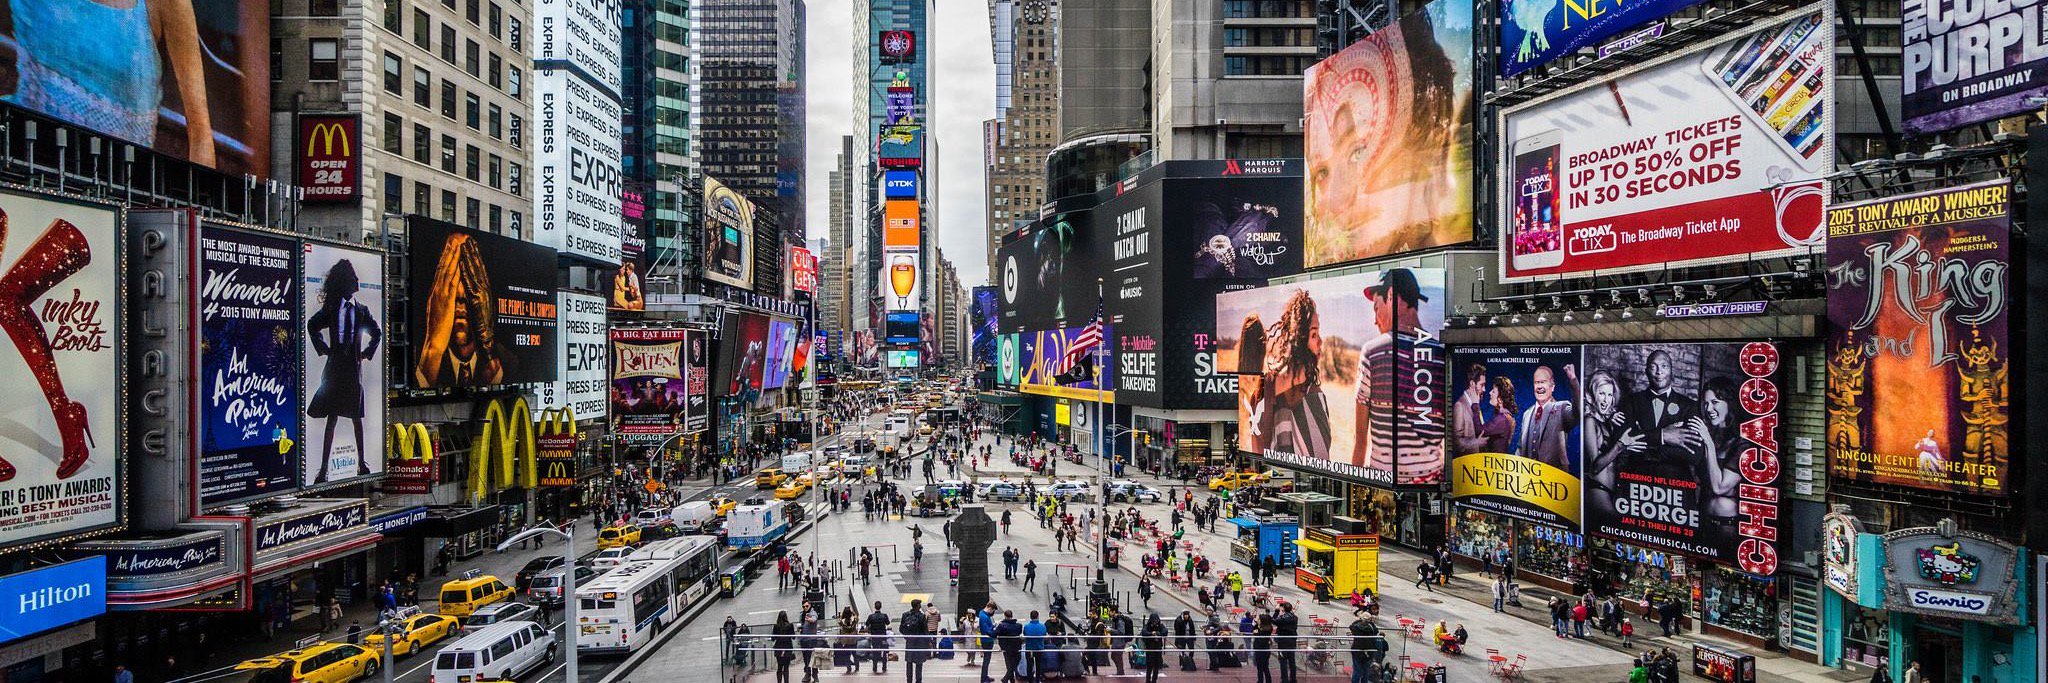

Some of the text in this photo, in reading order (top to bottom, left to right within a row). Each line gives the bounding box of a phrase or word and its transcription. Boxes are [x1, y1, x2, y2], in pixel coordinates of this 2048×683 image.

[576, 2, 606, 35] EXPRESS
[576, 48, 606, 80] EXPRESS
[1943, 69, 2033, 103] ON BROADWAY
[593, 98, 620, 122] EXPRESS
[543, 93, 554, 154] EXPRESS
[1569, 115, 1742, 168] BROADWAY TICKETS
[1569, 134, 1742, 188] UP TO 50% OFF
[315, 170, 343, 184] 24
[1525, 174, 1549, 186] TODAY
[1531, 183, 1544, 191] TIX
[1569, 160, 1742, 209] IN 30 SECONDS
[307, 187, 351, 195] HOURS
[543, 166, 554, 231] EXPRESS
[576, 190, 606, 213] EXPRESS
[1829, 185, 2008, 226] 2015 TONY AWARD WINNER!
[1117, 207, 1146, 236] 2 CHAINZ
[1573, 224, 1613, 240] TODAY
[1620, 216, 1742, 244] The Broadway Ticket App
[1829, 204, 2007, 236] BEST REVIVAL OF A MUSICAL
[203, 238, 217, 249] THE
[218, 240, 237, 252] MOST
[237, 244, 290, 260] AWARD-WINNING
[1114, 232, 1149, 261] WATCH OUT
[1247, 232, 1280, 242] 2 CHAINZ
[1582, 237, 1604, 251] TIX
[1943, 242, 1998, 253] HAMMERSTEIN'S
[1950, 236, 1981, 245] RODGERS
[206, 250, 288, 269] MUSICAL OF THE SEASON!
[1240, 243, 1264, 257] Watch
[203, 268, 292, 306] Winner!
[1125, 287, 1142, 298] MUSIC
[1828, 234, 2009, 331] The King
[204, 302, 290, 321] 4 2015 TONY AWARDS
[508, 299, 525, 316] PEOPLE
[537, 302, 556, 318] SIMPSON
[575, 299, 604, 316] EXPRESS
[1730, 301, 1765, 313] PRIME
[50, 325, 111, 351] Boots
[143, 229, 168, 453] PALACE
[516, 334, 526, 346] FEB
[526, 334, 530, 346] 2
[642, 330, 659, 338] FAT
[1864, 328, 1916, 359] and
[228, 347, 249, 378] An
[1121, 353, 1156, 376] SELFIE
[212, 369, 287, 406] American
[1121, 376, 1156, 392] TAKEOVER
[1413, 326, 1433, 426] AE.COM
[225, 399, 272, 427] Paris
[576, 399, 604, 415] EXPRESS
[537, 438, 575, 446] McDonald's
[1263, 448, 1393, 483] AMERICAN EAGLE OUTFITTERS
[1484, 455, 1542, 477] FINDING
[1738, 341, 1779, 576] CHICAGO
[1836, 450, 1881, 464] LINCOLN
[1885, 455, 1931, 468] CENTER
[1938, 460, 1997, 477] THEATER
[18, 477, 111, 505] 6 TONY AWARDS
[1461, 465, 1568, 501] NEVERLAND
[1619, 472, 1697, 490] STARRING NFL LEGEND
[22, 493, 112, 514] BEST MUSICAL
[1629, 483, 1683, 507] EDDIE
[40, 512, 49, 520] FOR
[50, 508, 70, 519] TICKETS
[70, 507, 81, 516] CALL
[1470, 497, 1557, 521] BROADWAY'S SOARING NEW HIT!
[1615, 497, 1700, 528] GEORGE
[261, 530, 275, 549] An
[277, 524, 320, 546] American
[321, 513, 344, 531] Paris
[385, 511, 427, 533] MONEY ATM
[1621, 517, 1694, 537] JAN 12 THRU FEB 28
[1536, 525, 1584, 549] GRAND
[1601, 525, 1718, 557] CHICAGOTHEMUSICAL.COM
[116, 555, 128, 571] An
[130, 552, 180, 571] American
[183, 544, 204, 563] Paris
[1616, 541, 1665, 568] SLAM
[1829, 568, 1847, 587] Sanrio
[18, 581, 91, 615] Hilton
[1914, 591, 1984, 611] Sanrio
